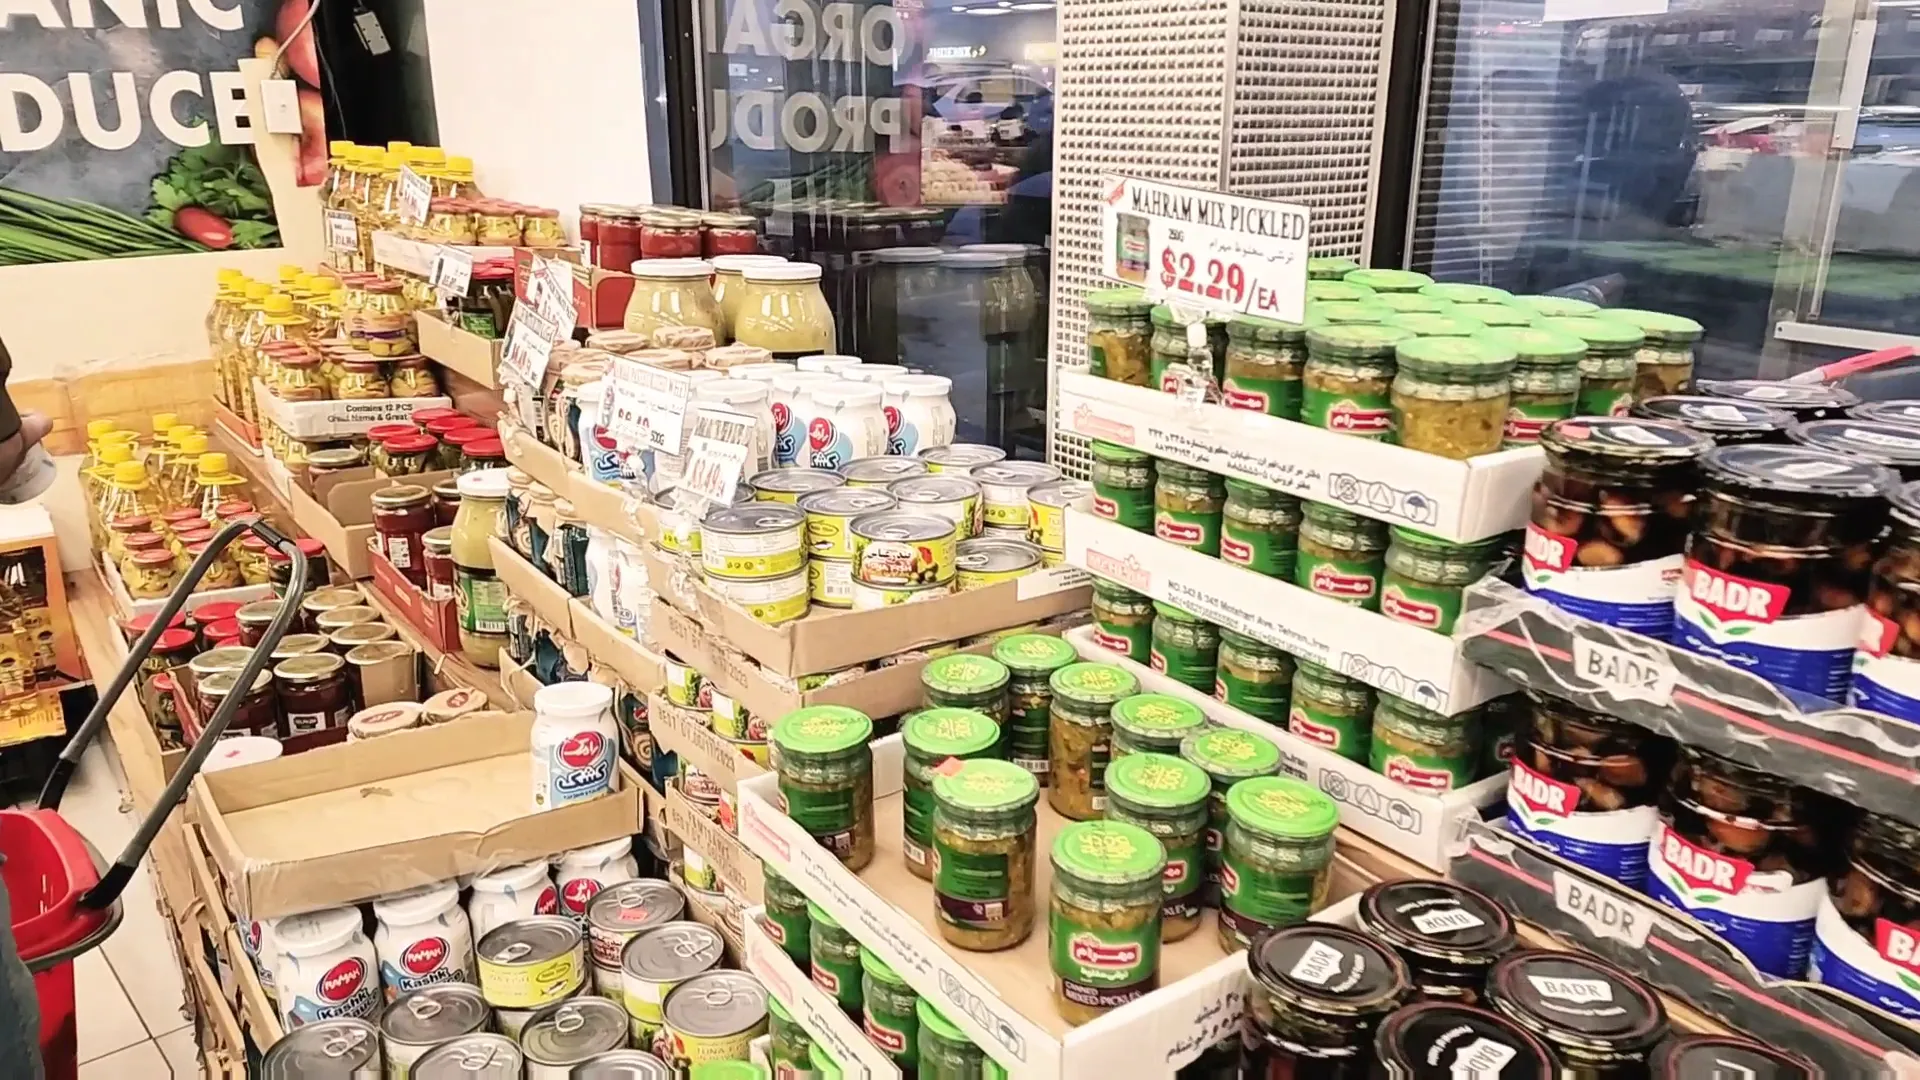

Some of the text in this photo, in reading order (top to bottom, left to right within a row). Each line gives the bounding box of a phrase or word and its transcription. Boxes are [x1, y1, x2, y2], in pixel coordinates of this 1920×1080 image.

[1132, 186, 1306, 241] MAHRAM MIX PICKLED
[345, 403, 413, 412] Contains 12 PCS
[385, 412, 407, 422] Great
[1692, 570, 1774, 619] BADR
[1587, 648, 1661, 692] BADR
[558, 762, 608, 790] کشک
[1513, 768, 1566, 813] BADR
[1664, 836, 1736, 890] BADR
[1566, 884, 1638, 937] BADR
[407, 946, 442, 963] RAMAK
[1075, 945, 1136, 963] مهرام
[1302, 949, 1337, 980] BADR
[324, 966, 361, 992] RAMAK
[402, 968, 449, 992] Kashk
[1542, 979, 1600, 997] BADR
[320, 987, 369, 1019] Kashk
[1065, 989, 1100, 1006] MIXED
